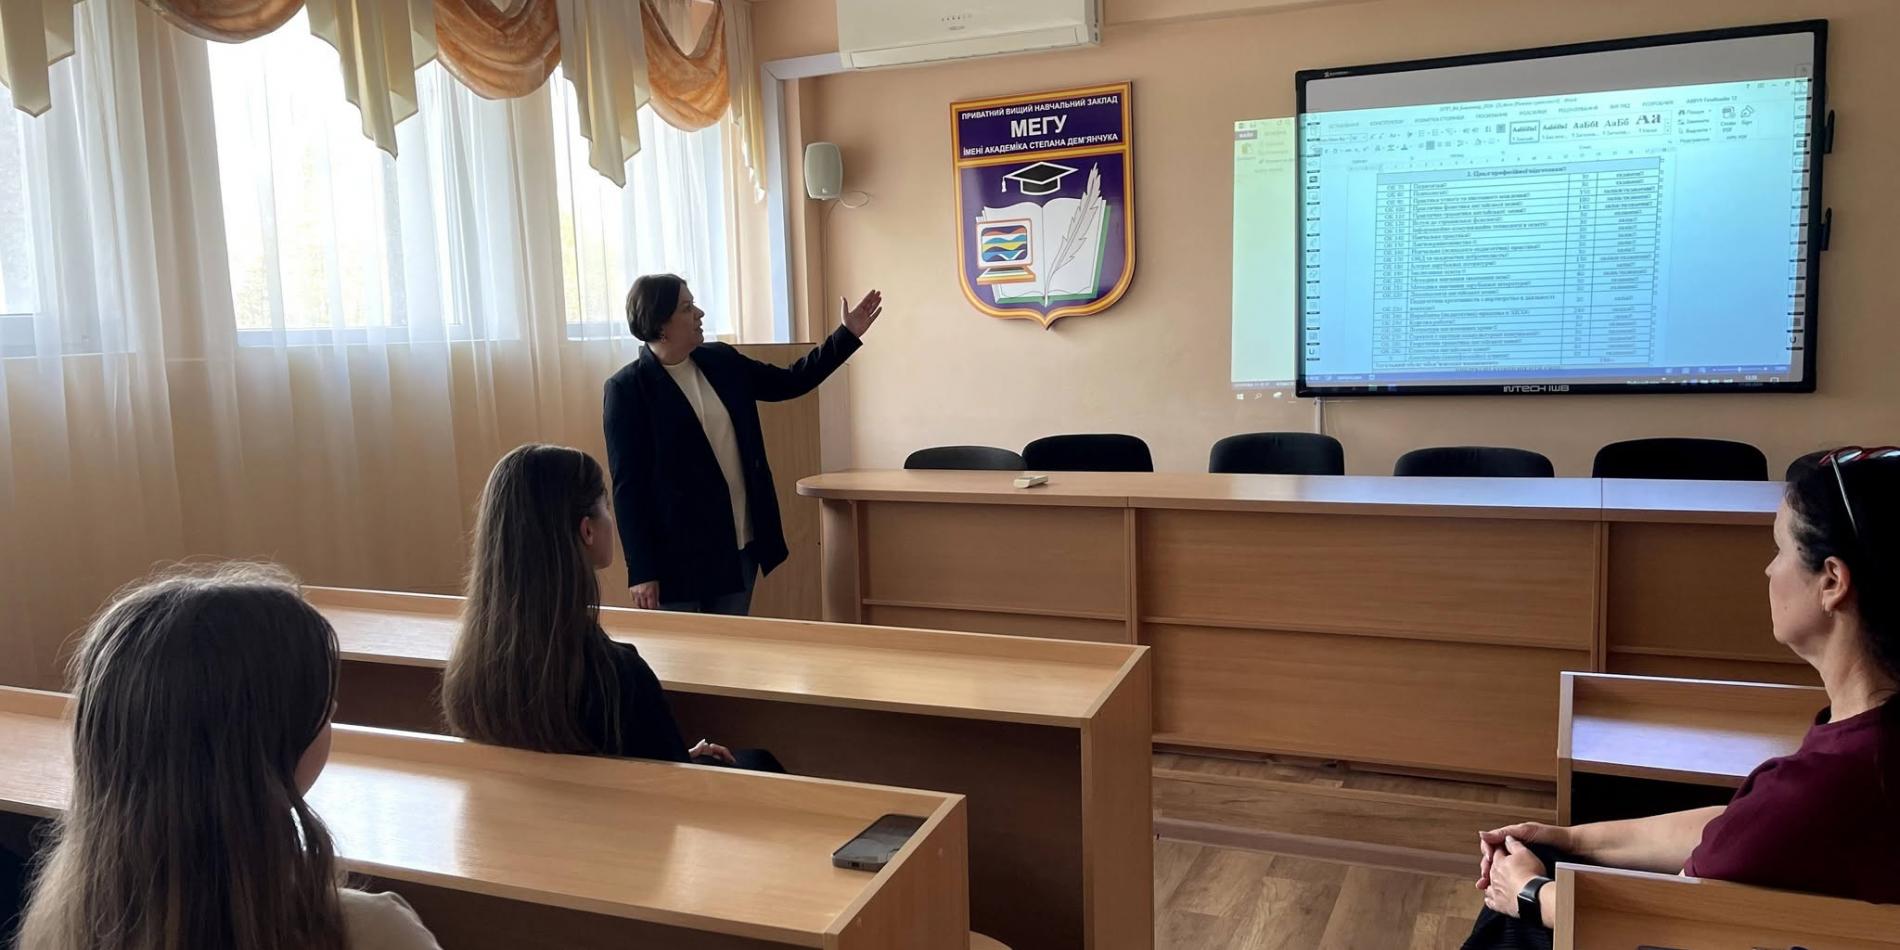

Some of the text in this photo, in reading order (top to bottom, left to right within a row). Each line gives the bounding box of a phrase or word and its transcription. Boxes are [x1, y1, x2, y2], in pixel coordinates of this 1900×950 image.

[962, 95, 1118, 120] ПРИВАТНИЙ ВИЩИЙ НАВЧАЛЬНИЙ ЗАКЛАД
[1010, 114, 1068, 138] МЕГУ
[1029, 138, 1066, 149] СТЕПАНА
